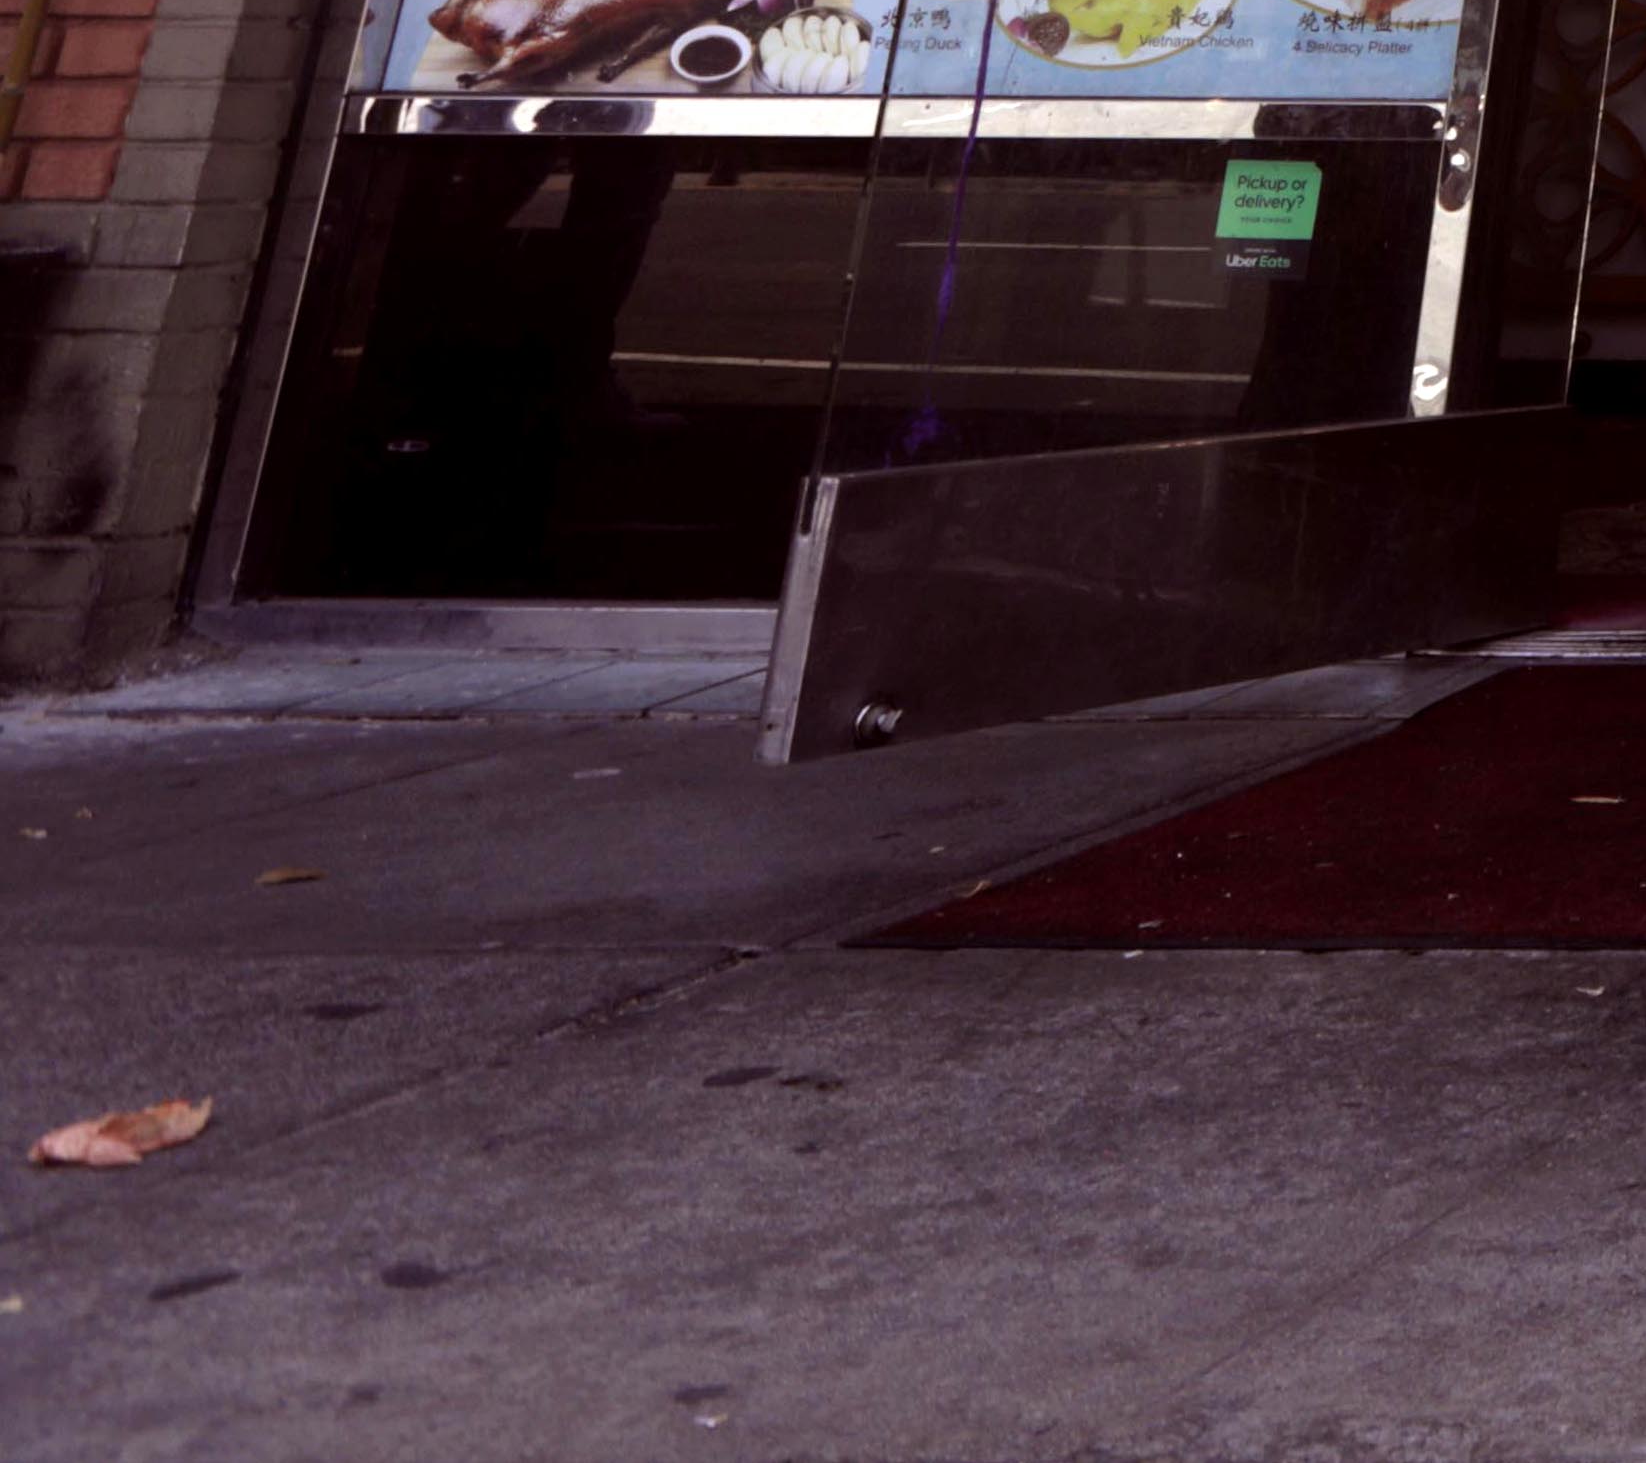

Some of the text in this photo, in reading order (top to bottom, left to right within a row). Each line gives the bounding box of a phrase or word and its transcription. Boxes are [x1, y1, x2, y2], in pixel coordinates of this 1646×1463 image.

[925, 36, 962, 51] Duck
[1139, 34, 1254, 48] Vietnam Chicken
[1305, 40, 1364, 56] Delicacy
[1368, 40, 1413, 53] Platter
[1238, 174, 1307, 192] Pickup or
[1234, 193, 1305, 212] delivery?
[1226, 253, 1291, 268] Uber Eats
